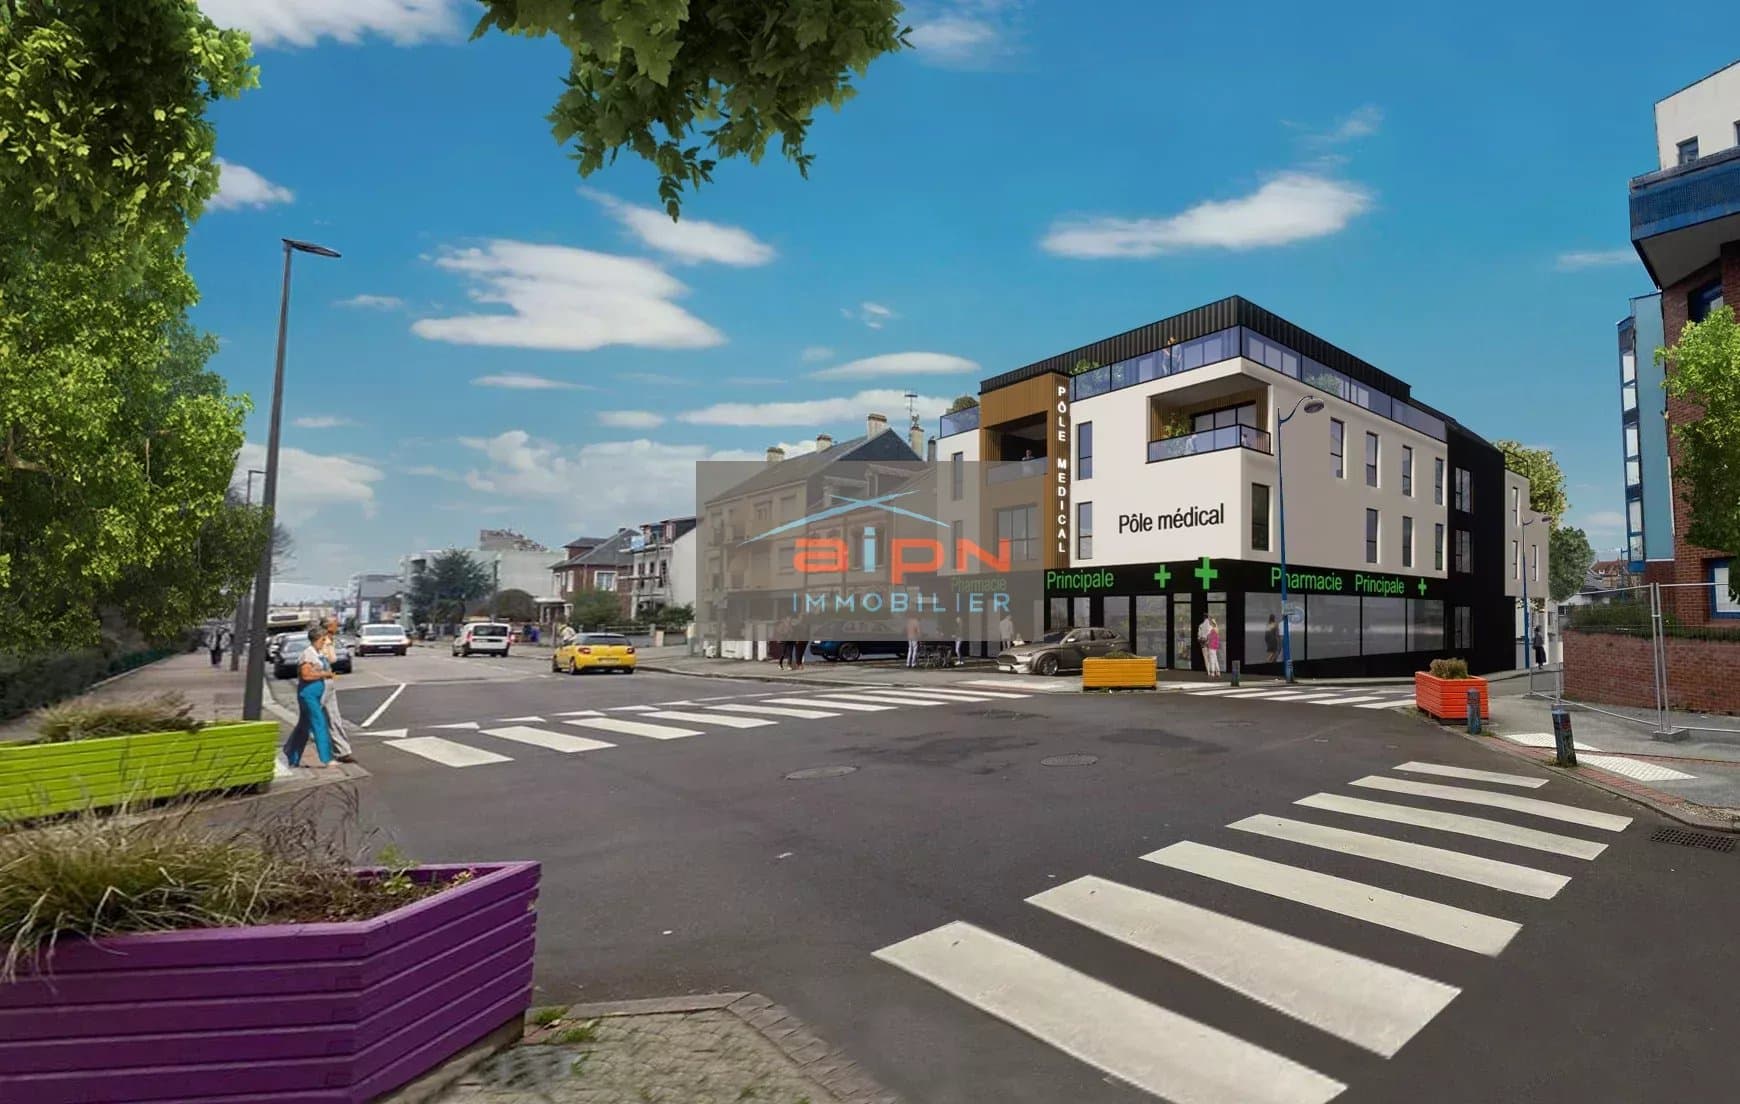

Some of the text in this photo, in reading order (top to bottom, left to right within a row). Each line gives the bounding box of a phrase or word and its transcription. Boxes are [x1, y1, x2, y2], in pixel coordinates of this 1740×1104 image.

[1057, 386, 1068, 553] PÔLE MEDICAL
[1118, 503, 1225, 534] Pôle médical
[951, 569, 1115, 593] Pharmacie Principale
[1355, 574, 1405, 597] Principale
